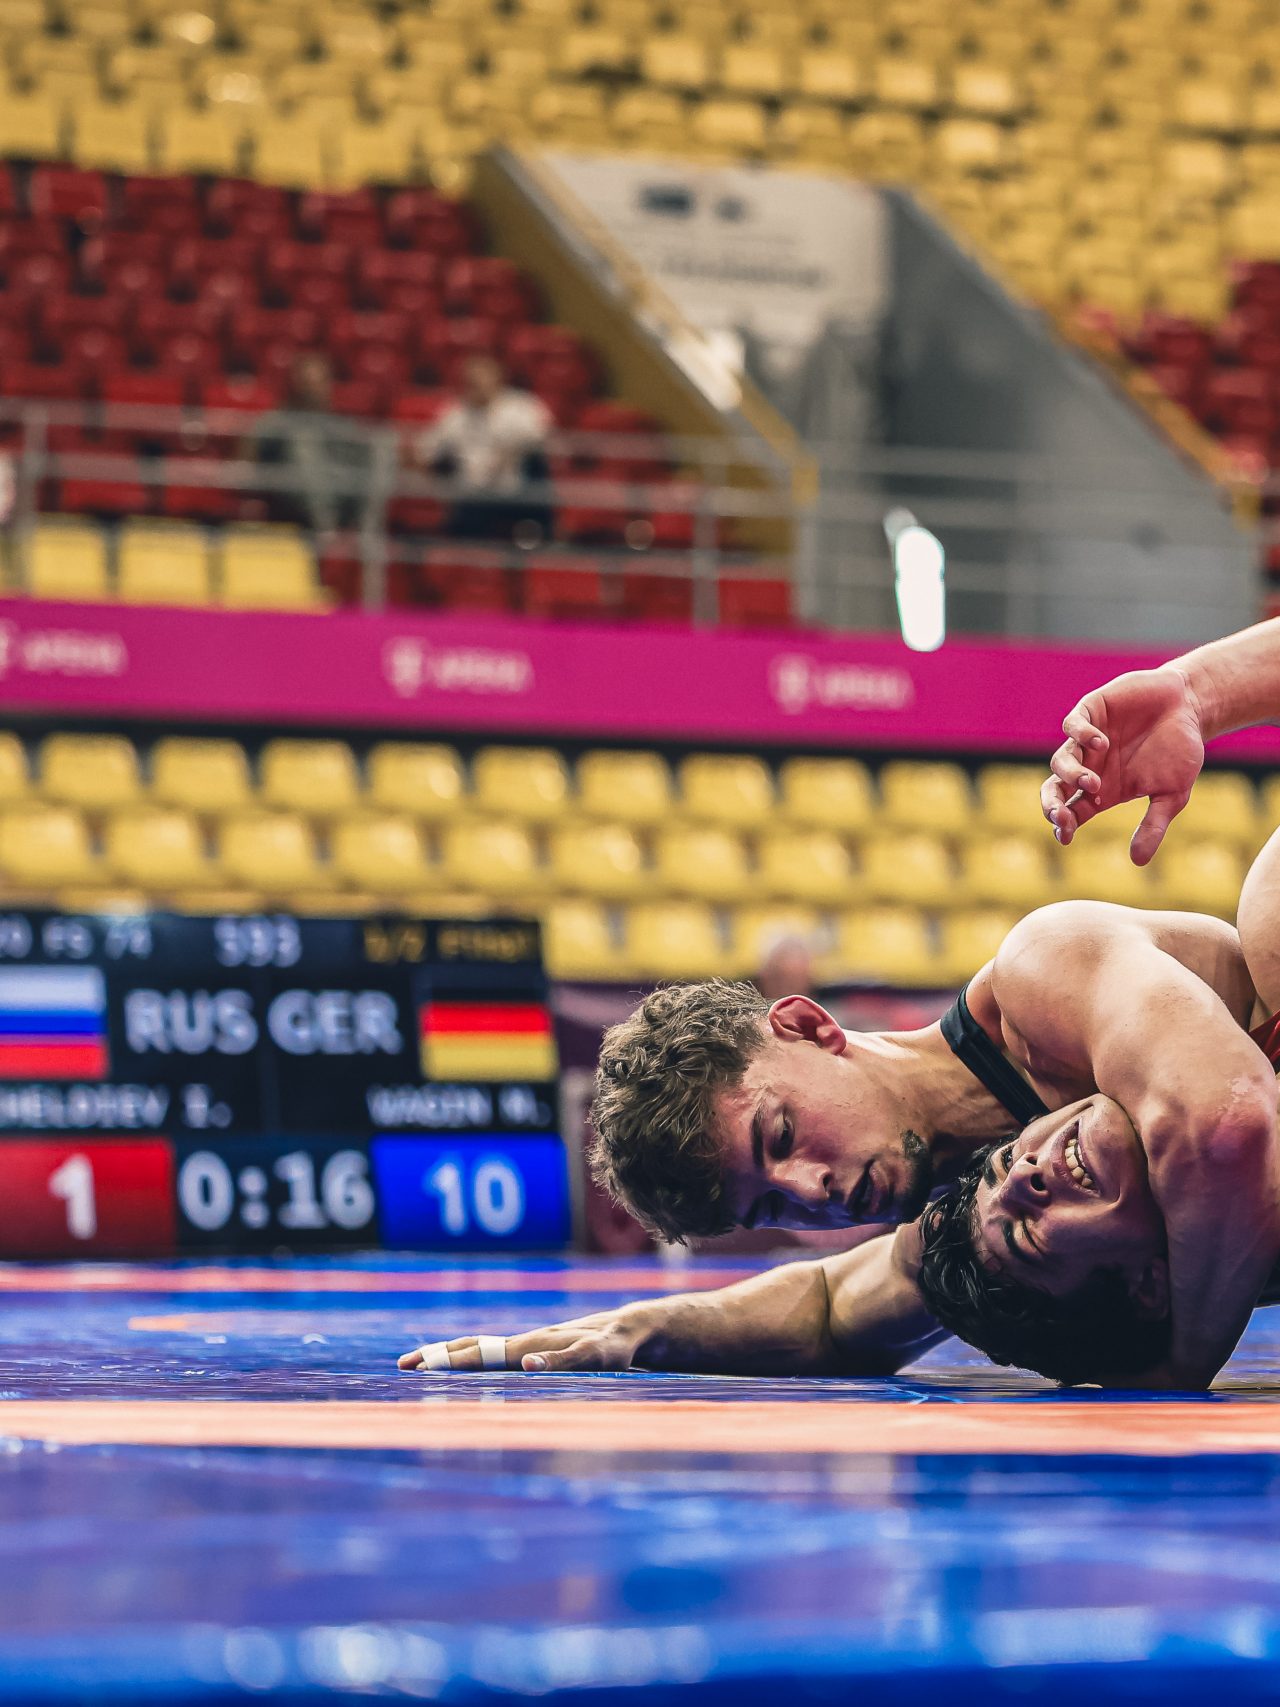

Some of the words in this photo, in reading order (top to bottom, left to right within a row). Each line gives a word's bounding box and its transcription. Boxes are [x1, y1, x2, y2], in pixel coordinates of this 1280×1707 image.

[125, 989, 258, 1054] RUS
[267, 989, 402, 1055] GER
[50, 1153, 97, 1240] 1
[179, 1149, 376, 1231] 0:16
[424, 1155, 524, 1236] 10
